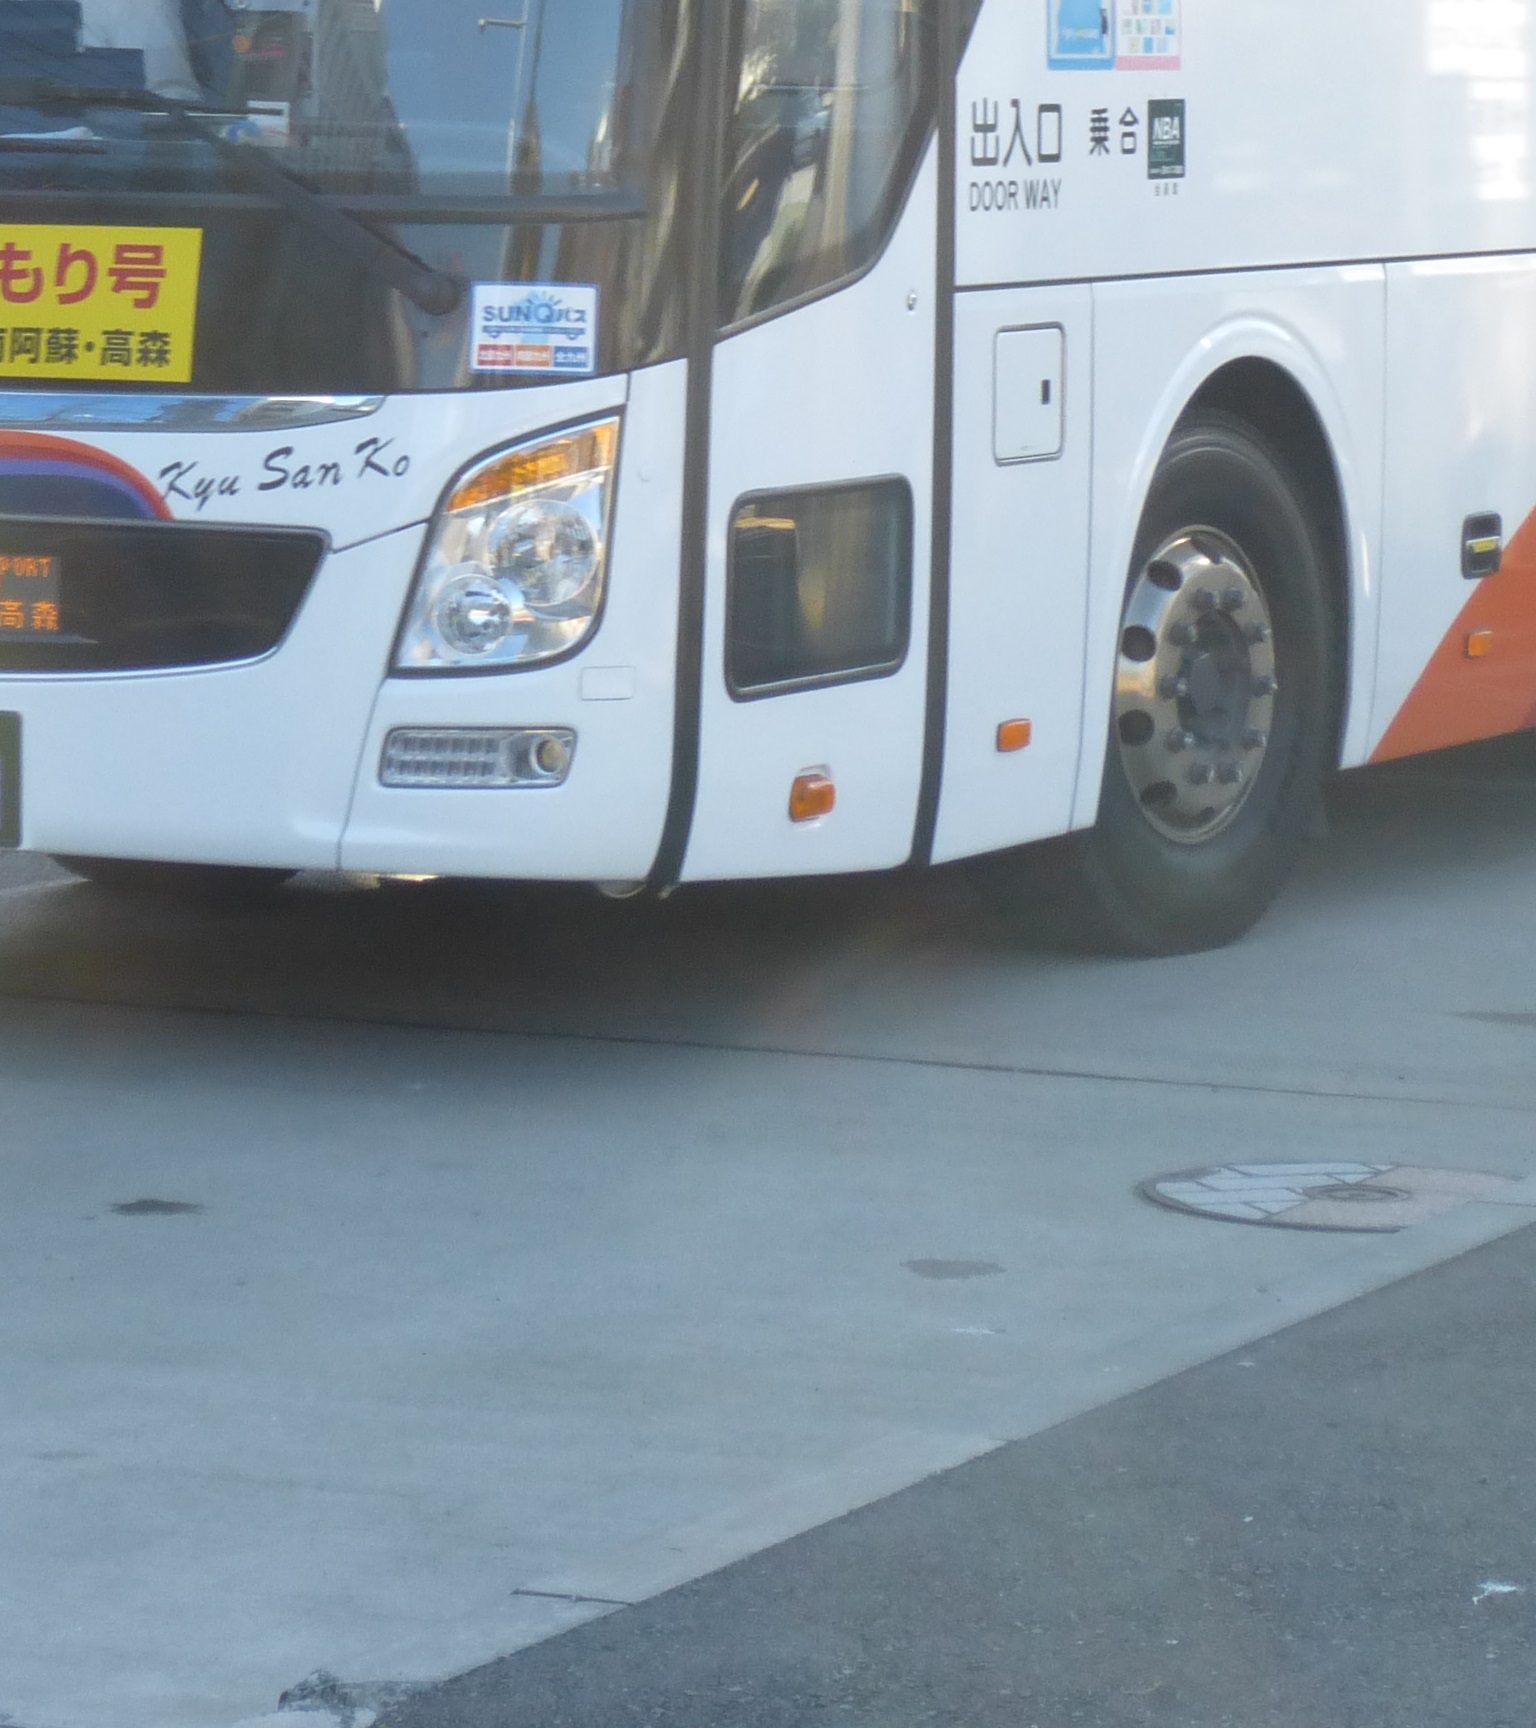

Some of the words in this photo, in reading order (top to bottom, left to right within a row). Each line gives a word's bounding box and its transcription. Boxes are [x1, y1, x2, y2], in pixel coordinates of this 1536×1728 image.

[970, 97, 1063, 168] 出入口
[1088, 105, 1141, 157] 乗合
[1152, 116, 1180, 141] NBA
[969, 180, 1019, 213] DOOR
[1024, 177, 1063, 211] WAY
[159, 459, 241, 508] Kyu
[263, 446, 343, 497] San
[355, 436, 412, 482] Ko
